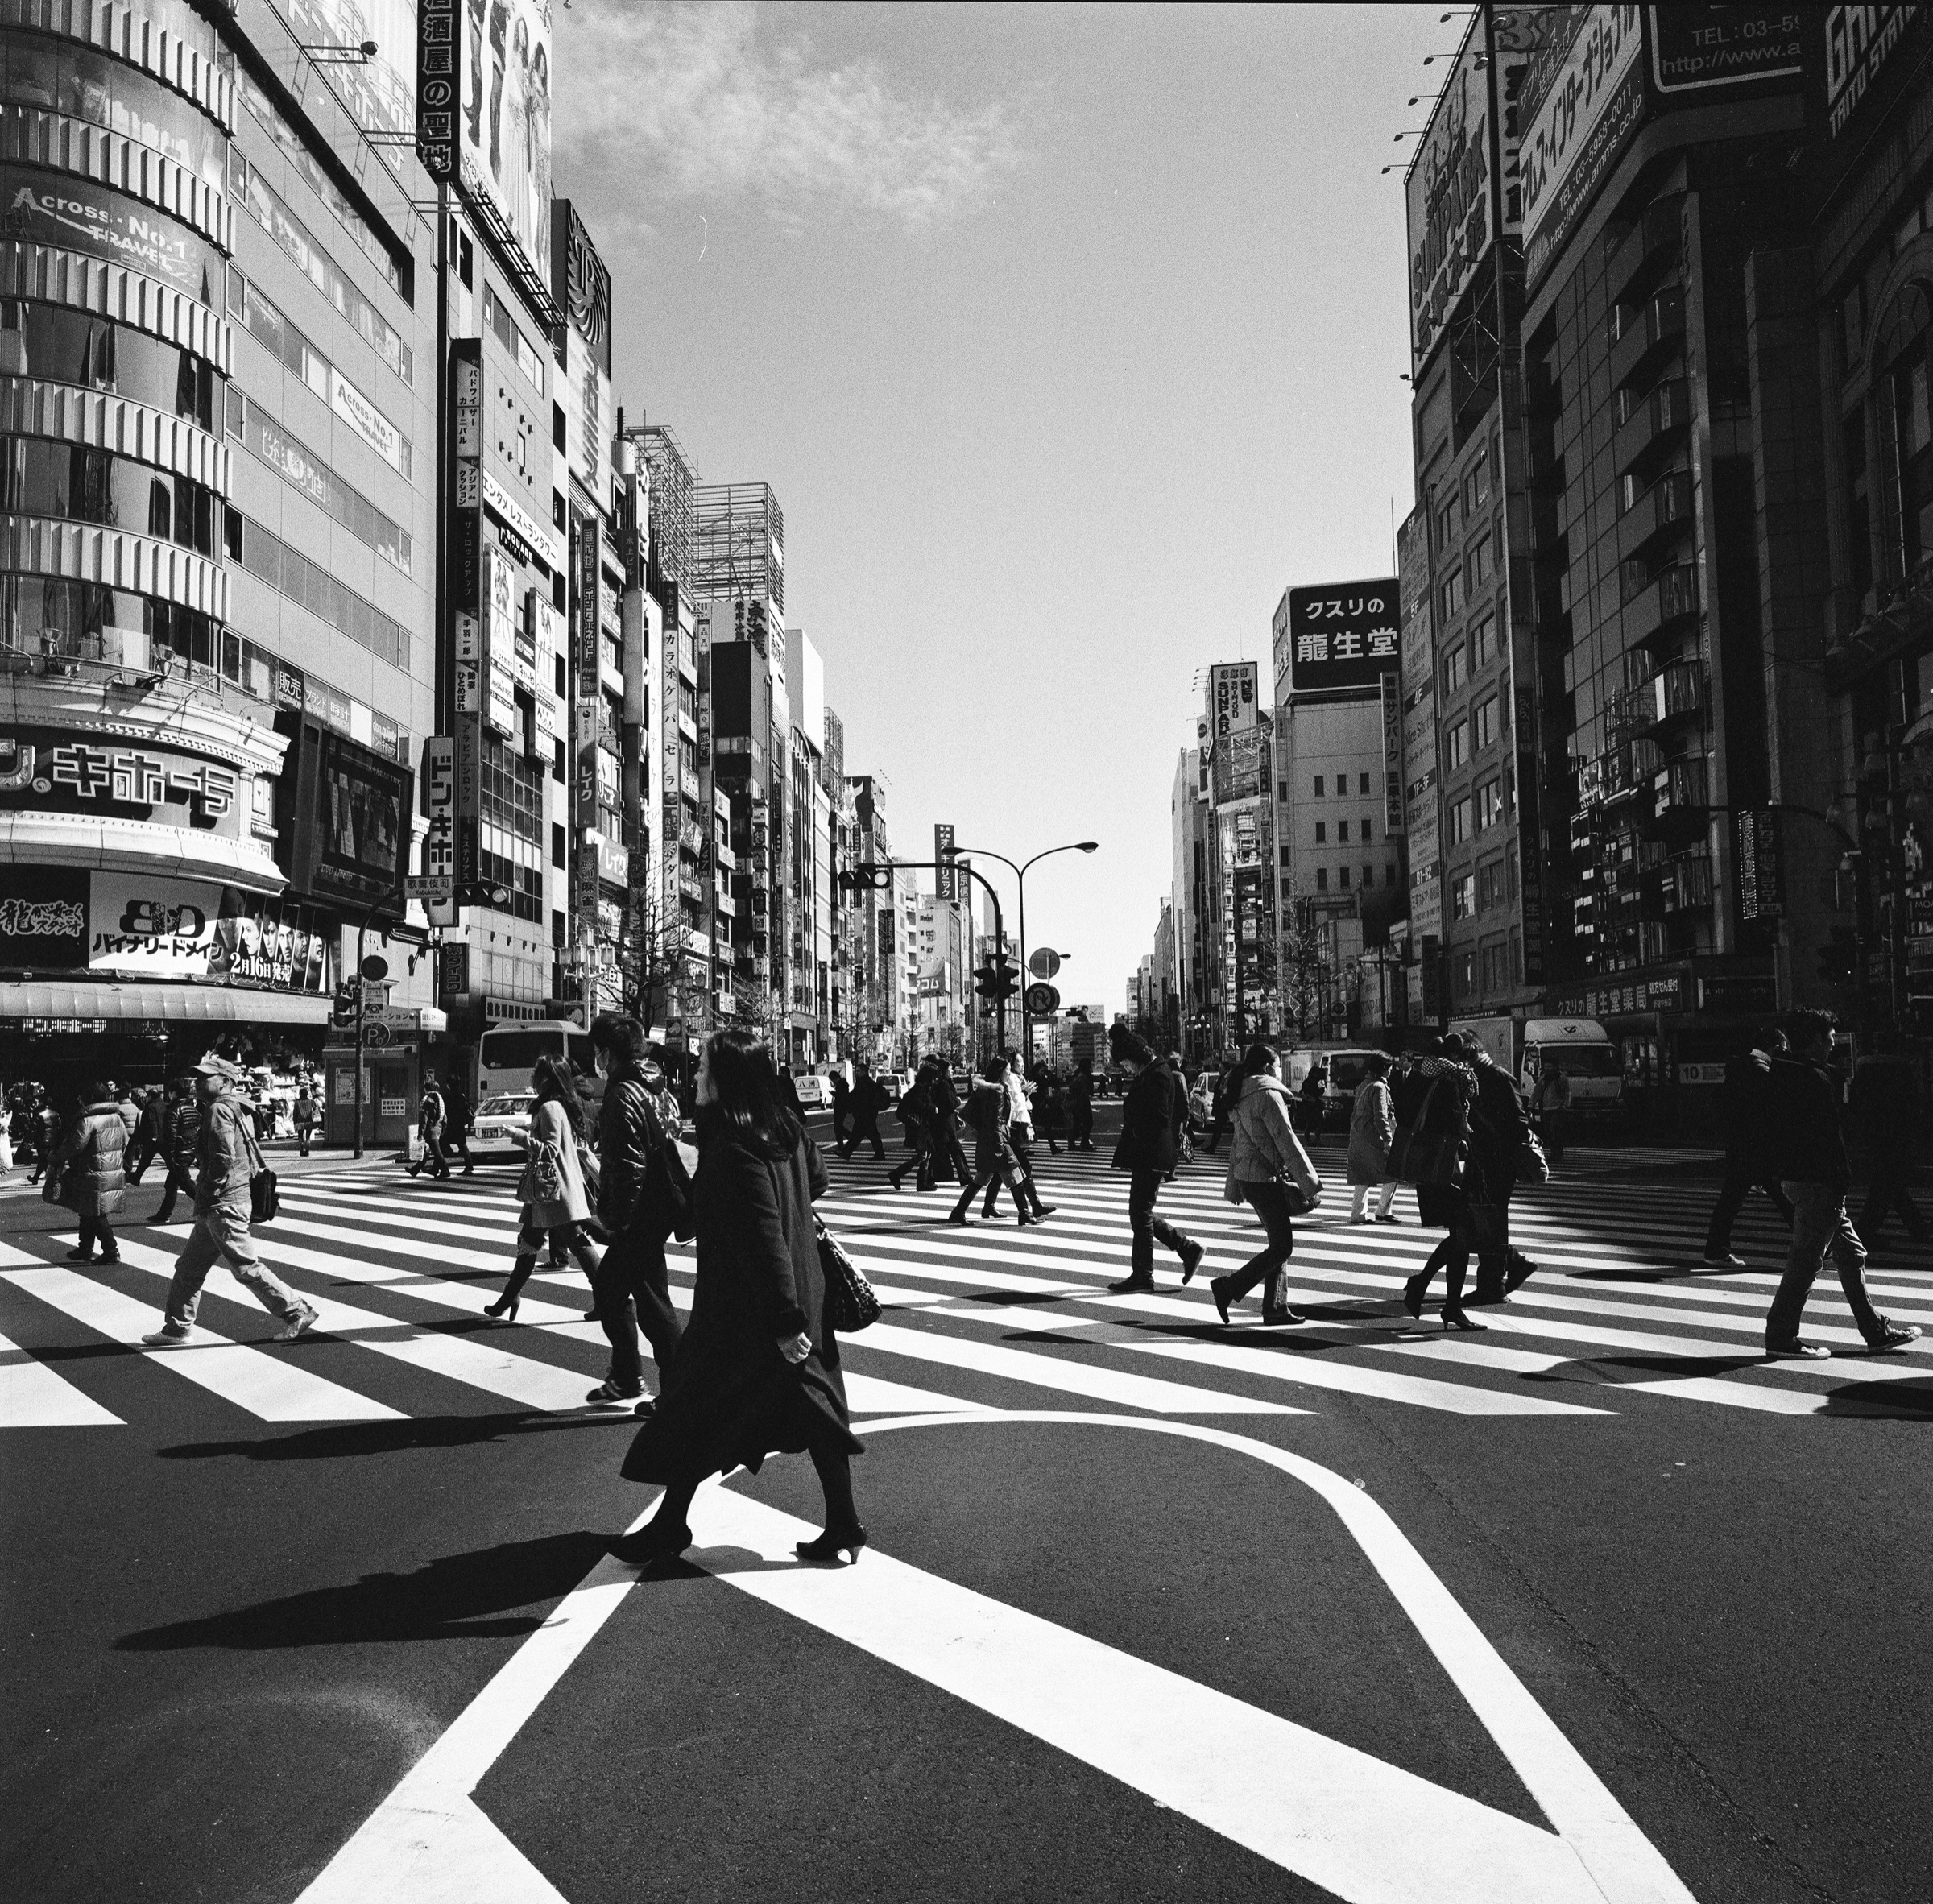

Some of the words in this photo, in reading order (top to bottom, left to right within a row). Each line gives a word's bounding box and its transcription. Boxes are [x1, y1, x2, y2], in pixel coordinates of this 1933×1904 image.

[1413, 113, 1488, 309] SUNPARK
[1306, 598, 1384, 619] クスリの
[1297, 627, 1397, 662] 龍生堂
[581, 765, 592, 801] レイク
[940, 838, 950, 897] オキリニック
[408, 879, 449, 889] 歌舞伎町
[93, 933, 223, 960] バイナリードメイン
[230, 952, 291, 981] 2月16日発売
[1682, 1066, 1699, 1080] 10
